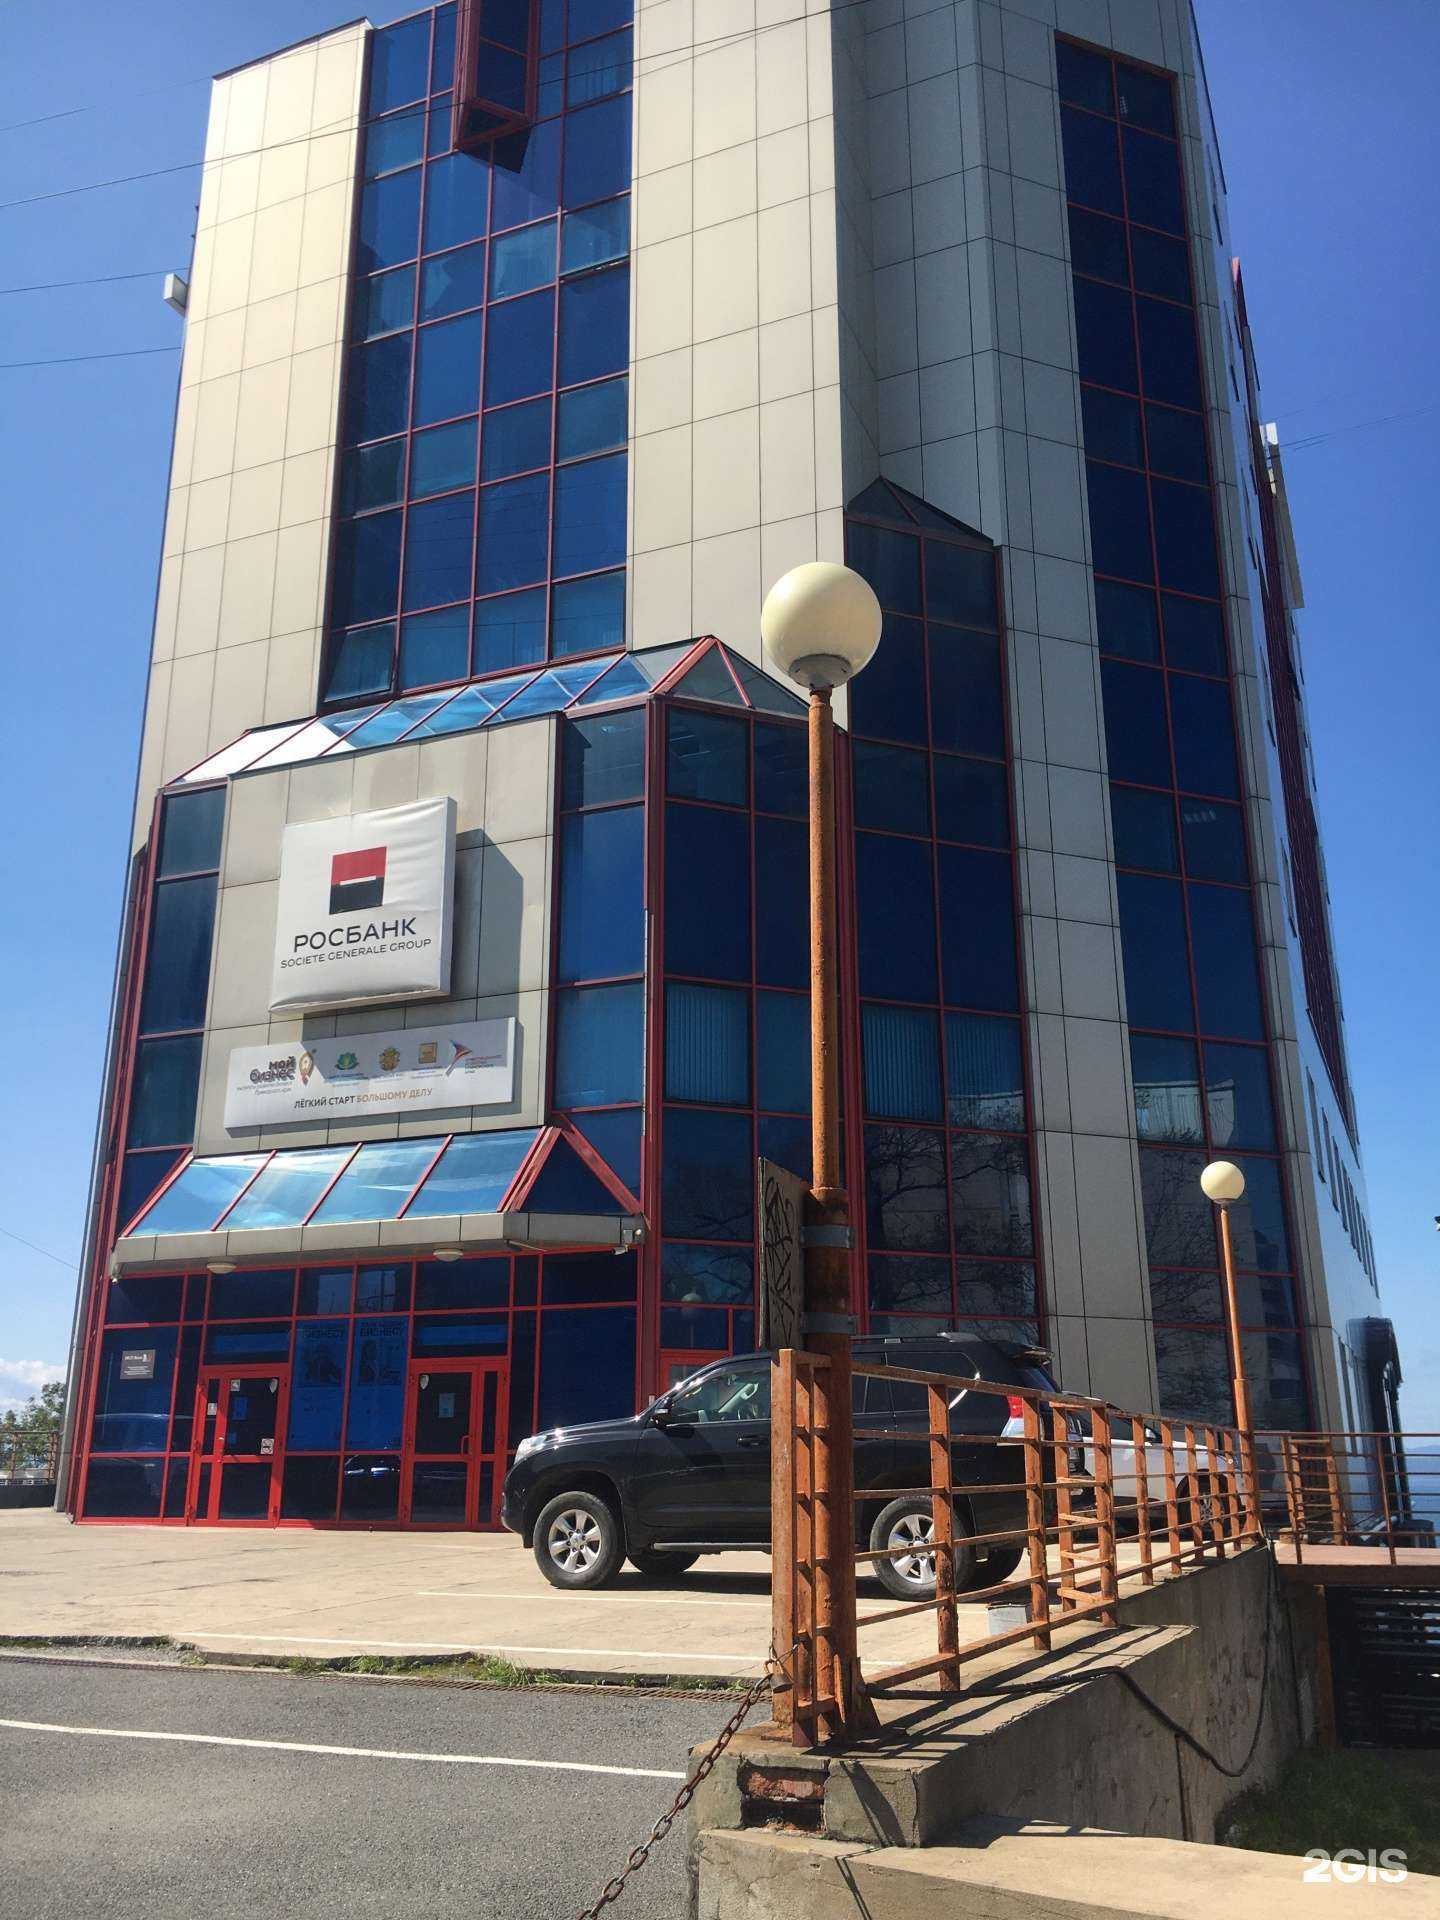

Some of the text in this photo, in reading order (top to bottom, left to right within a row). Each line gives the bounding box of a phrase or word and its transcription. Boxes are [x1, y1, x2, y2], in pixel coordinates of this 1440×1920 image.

[294, 917, 417, 953] РОСБАНК
[280, 938, 432, 969] SOCIETE GENERALE GROUP
[328, 1096, 356, 1106] СТАРТ
[357, 1090, 408, 1103] БОЛЬШОМУ
[409, 1088, 432, 1099] ДЕЛУ
